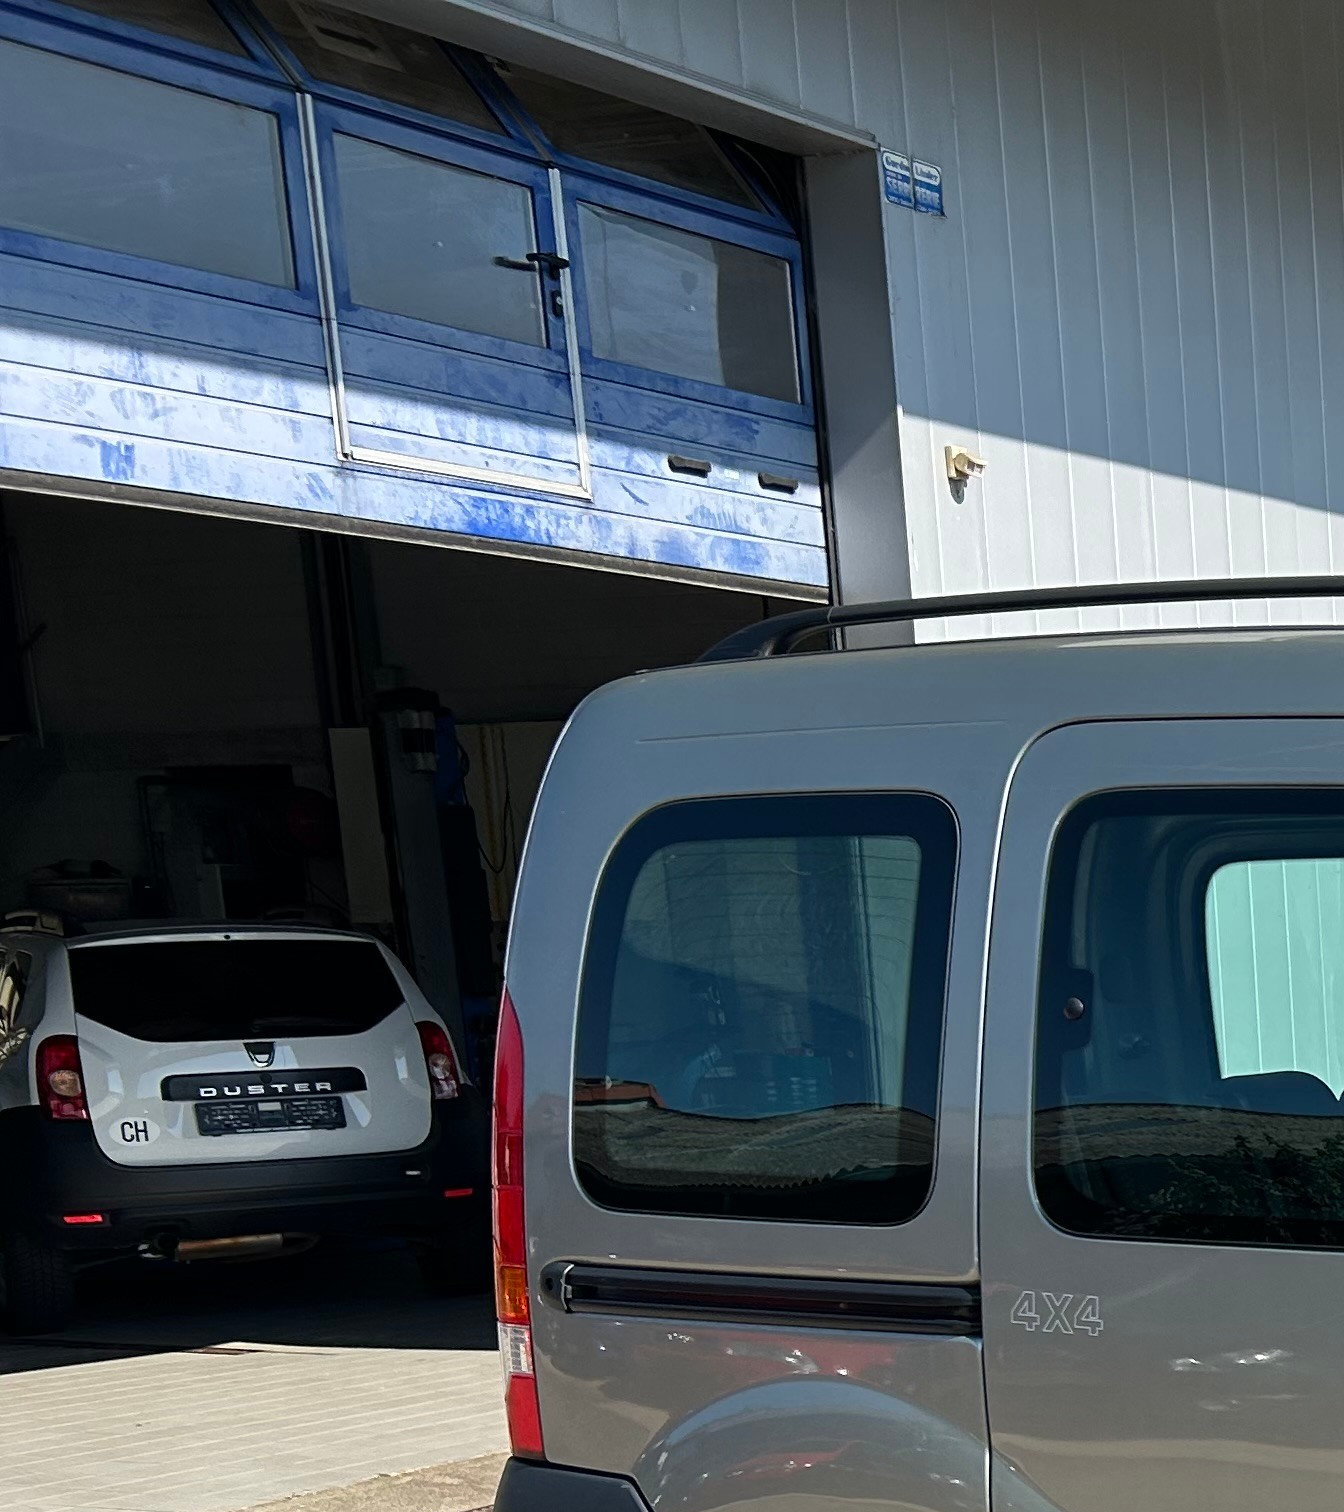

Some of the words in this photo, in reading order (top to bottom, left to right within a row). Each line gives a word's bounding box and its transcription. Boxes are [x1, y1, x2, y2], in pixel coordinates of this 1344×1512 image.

[199, 1082, 333, 1097] DUSTER
[120, 1120, 149, 1142] CH
[1010, 1290, 1104, 1336] 4X4
